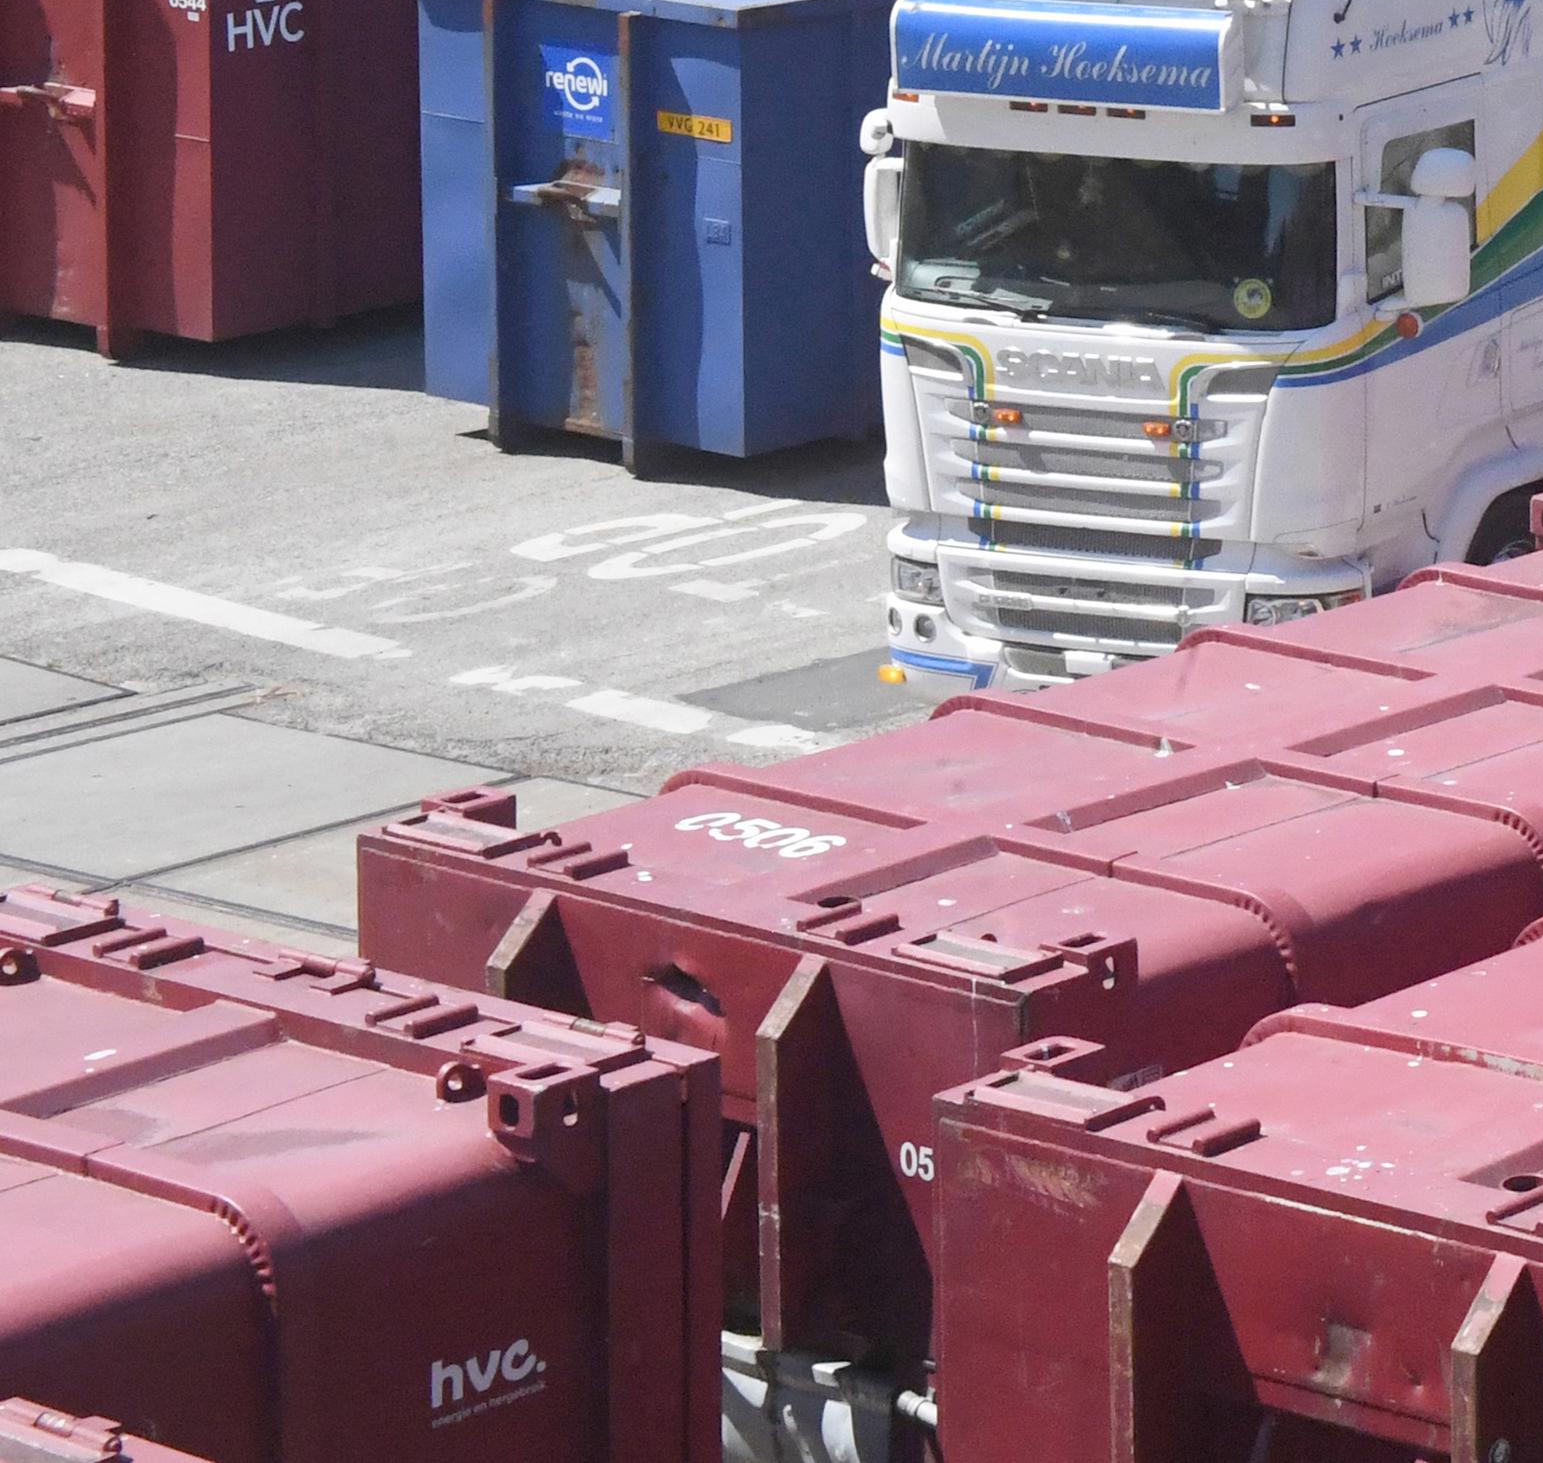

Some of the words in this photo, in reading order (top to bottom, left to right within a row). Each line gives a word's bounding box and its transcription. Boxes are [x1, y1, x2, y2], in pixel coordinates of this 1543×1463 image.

[226, 1, 305, 53] HVC
[1369, 19, 1443, 52] Hoeksema
[545, 65, 608, 100] renewi
[901, 31, 1030, 89] Martijn
[1039, 40, 1213, 89] Hoeksema
[667, 115, 693, 133] VVG
[699, 120, 721, 138] 241
[996, 345, 1167, 393] SCANIA
[674, 811, 848, 859] 0506
[430, 1338, 547, 1409] hvc.
